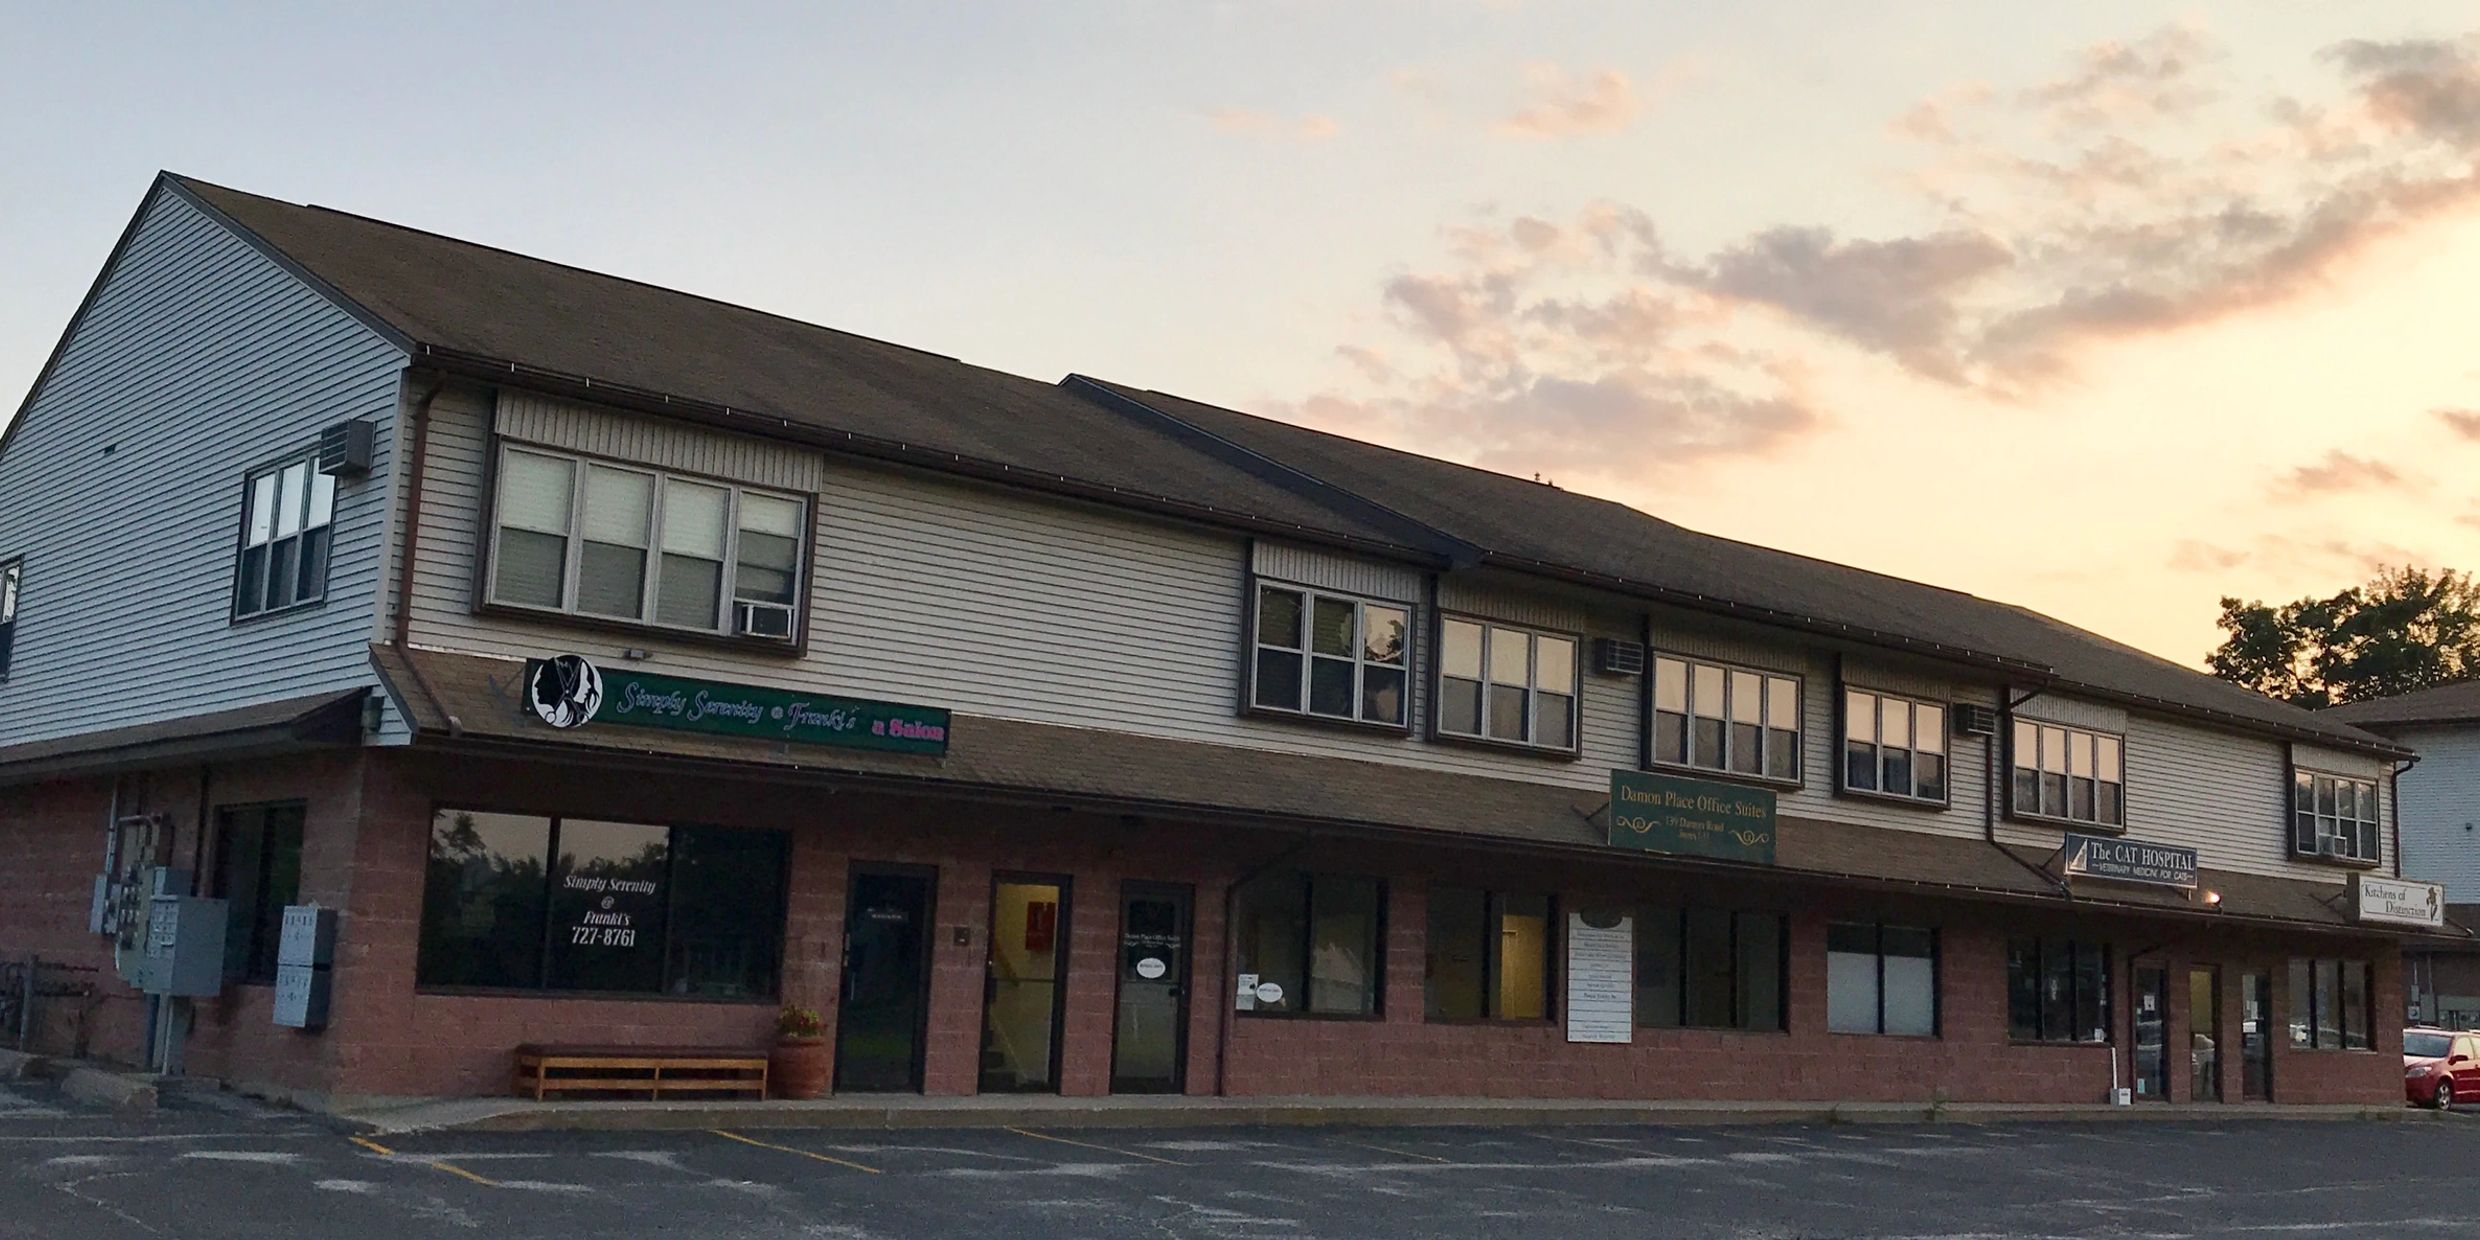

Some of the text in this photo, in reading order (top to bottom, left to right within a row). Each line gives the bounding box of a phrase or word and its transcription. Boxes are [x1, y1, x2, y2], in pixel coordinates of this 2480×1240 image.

[616, 681, 687, 716] Simply
[687, 689, 763, 724] Serenity
[872, 719, 885, 736] a
[889, 718, 944, 741] Salon
[1621, 784, 1767, 818] Damon Place Office Suites
[2091, 841, 2195, 871] The CAT HOSPITAL
[563, 875, 656, 895] Simply Serenity
[2364, 884, 2407, 901] Kitchens of
[601, 896, 615, 909] @
[572, 926, 636, 947] 727-8761
